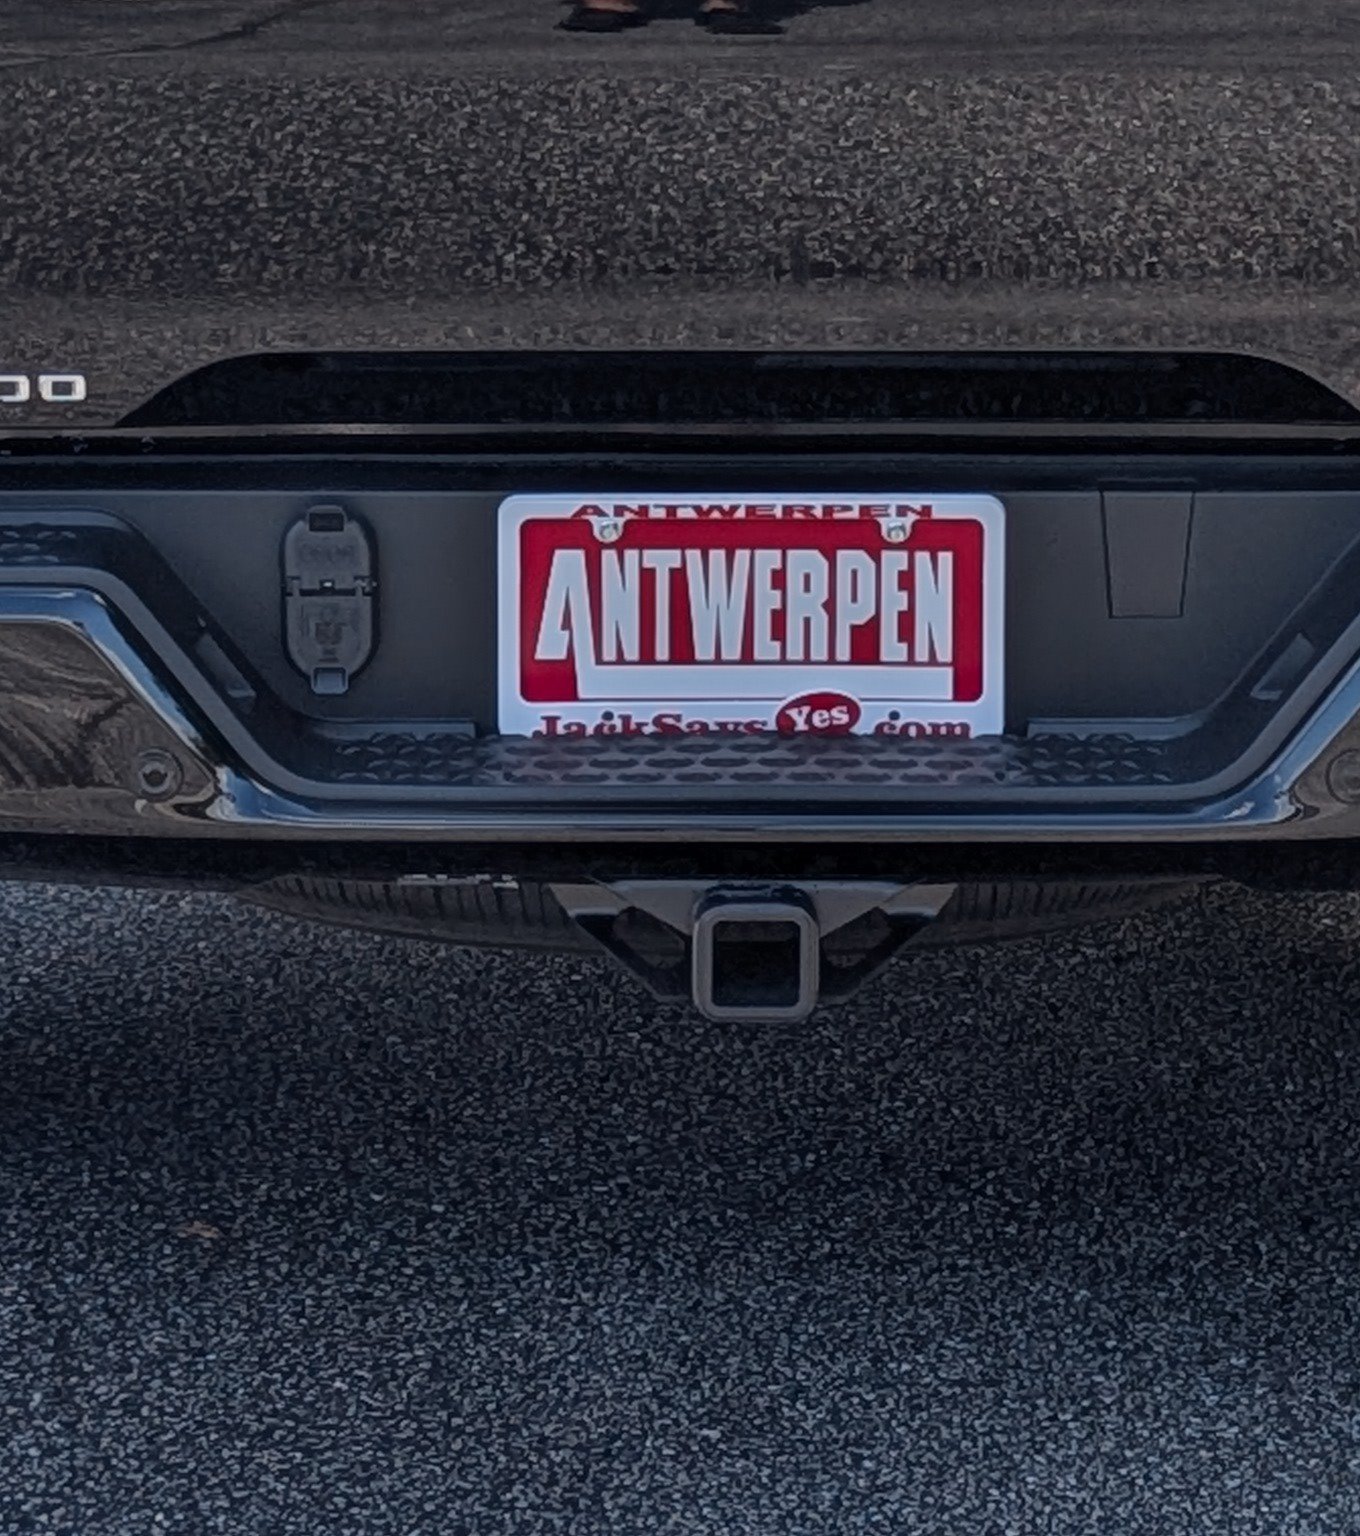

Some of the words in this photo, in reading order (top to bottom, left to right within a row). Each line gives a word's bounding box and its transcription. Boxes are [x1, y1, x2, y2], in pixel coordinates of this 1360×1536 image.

[570, 504, 934, 519] ANTWERPEN
[534, 547, 954, 701] ANTWERPEN
[786, 705, 850, 732] Yes
